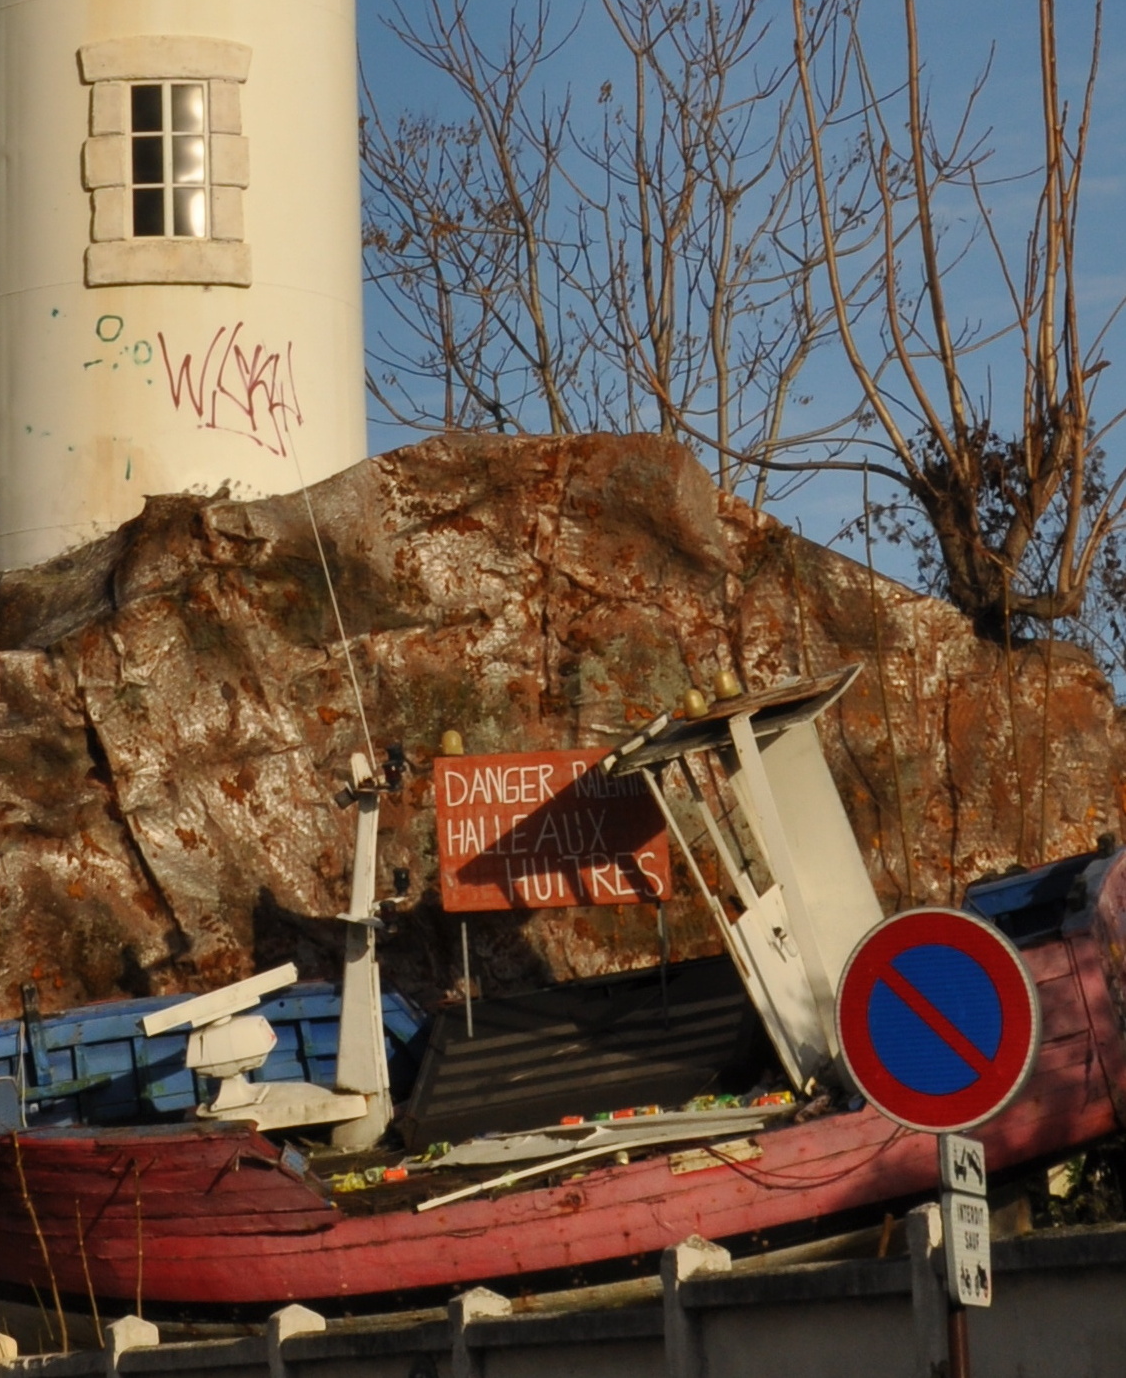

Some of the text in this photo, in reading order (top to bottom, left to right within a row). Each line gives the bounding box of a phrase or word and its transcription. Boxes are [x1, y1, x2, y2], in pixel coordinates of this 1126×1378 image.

[444, 764, 555, 807] DANGER
[447, 808, 608, 856] HALLE AUX
[957, 1202, 984, 1226] INTERDIT
[964, 1230, 980, 1251] SAUF
